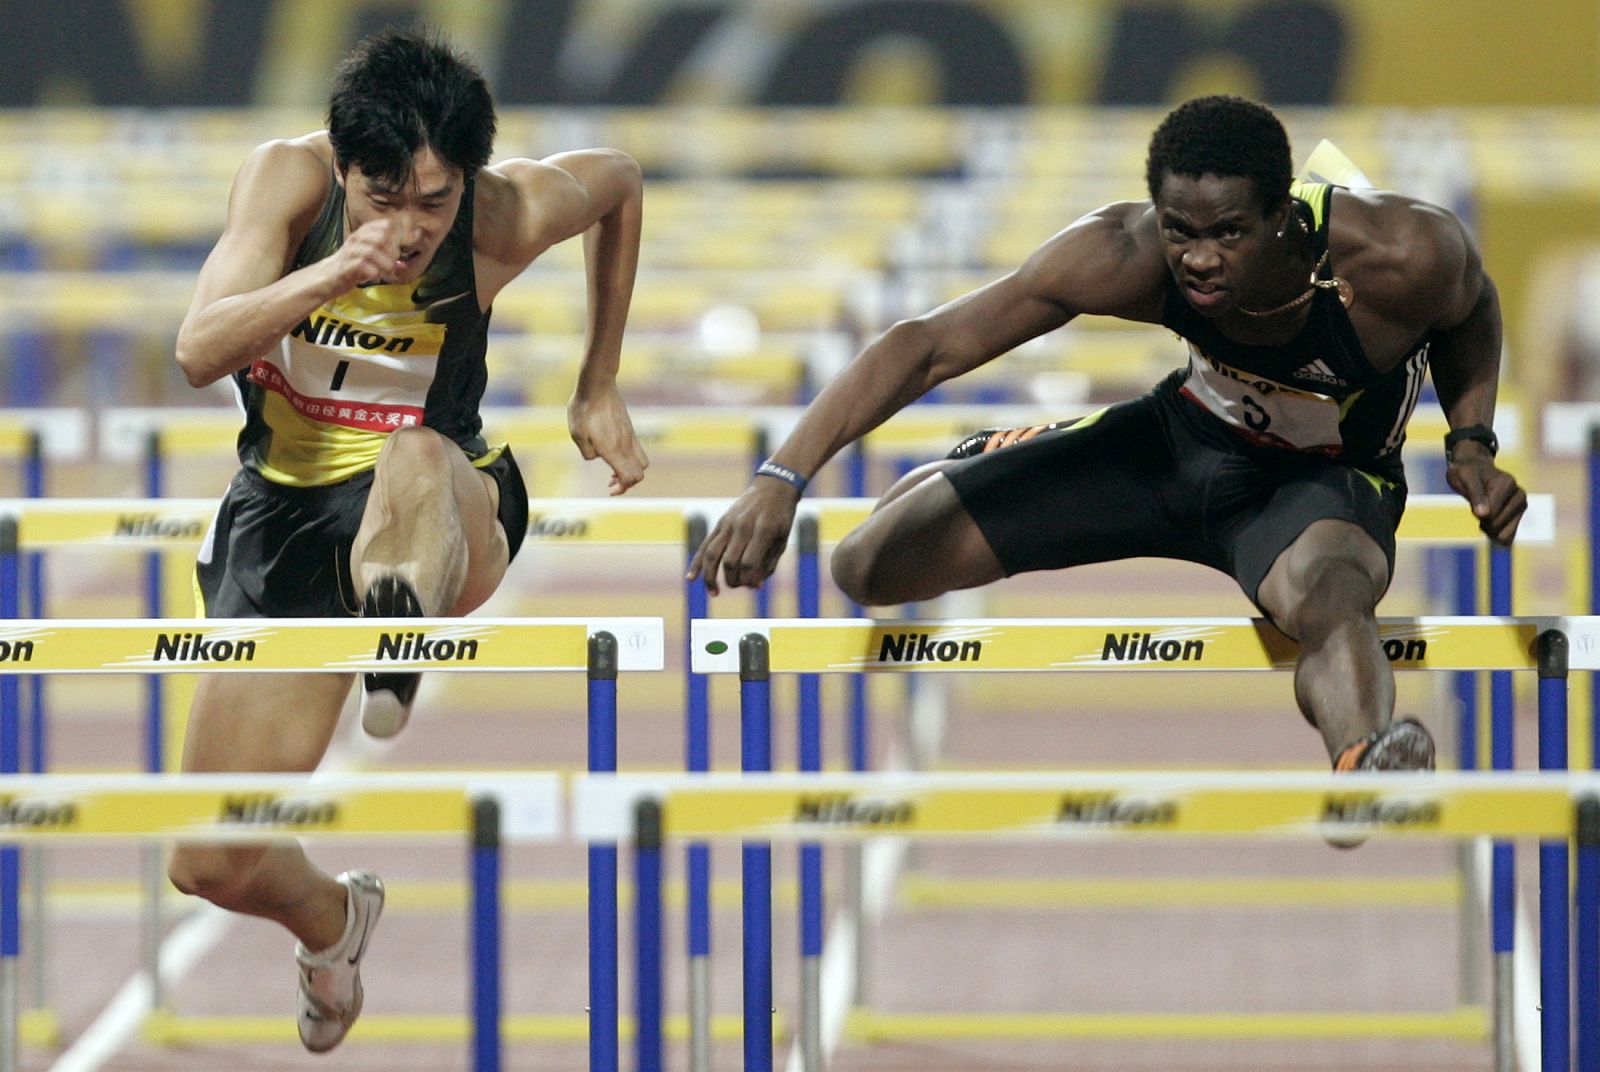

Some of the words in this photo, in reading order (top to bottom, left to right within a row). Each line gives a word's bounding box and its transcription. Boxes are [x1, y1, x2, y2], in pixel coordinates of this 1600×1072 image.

[290, 315, 414, 352] Nikon
[1293, 371, 1347, 387] adidas
[115, 512, 204, 537] Nikon
[153, 633, 256, 661] Nikon
[376, 633, 478, 661] Nikon
[878, 634, 982, 662] Nikon
[1101, 632, 1204, 661] Nikon
[1381, 638, 1427, 661] on
